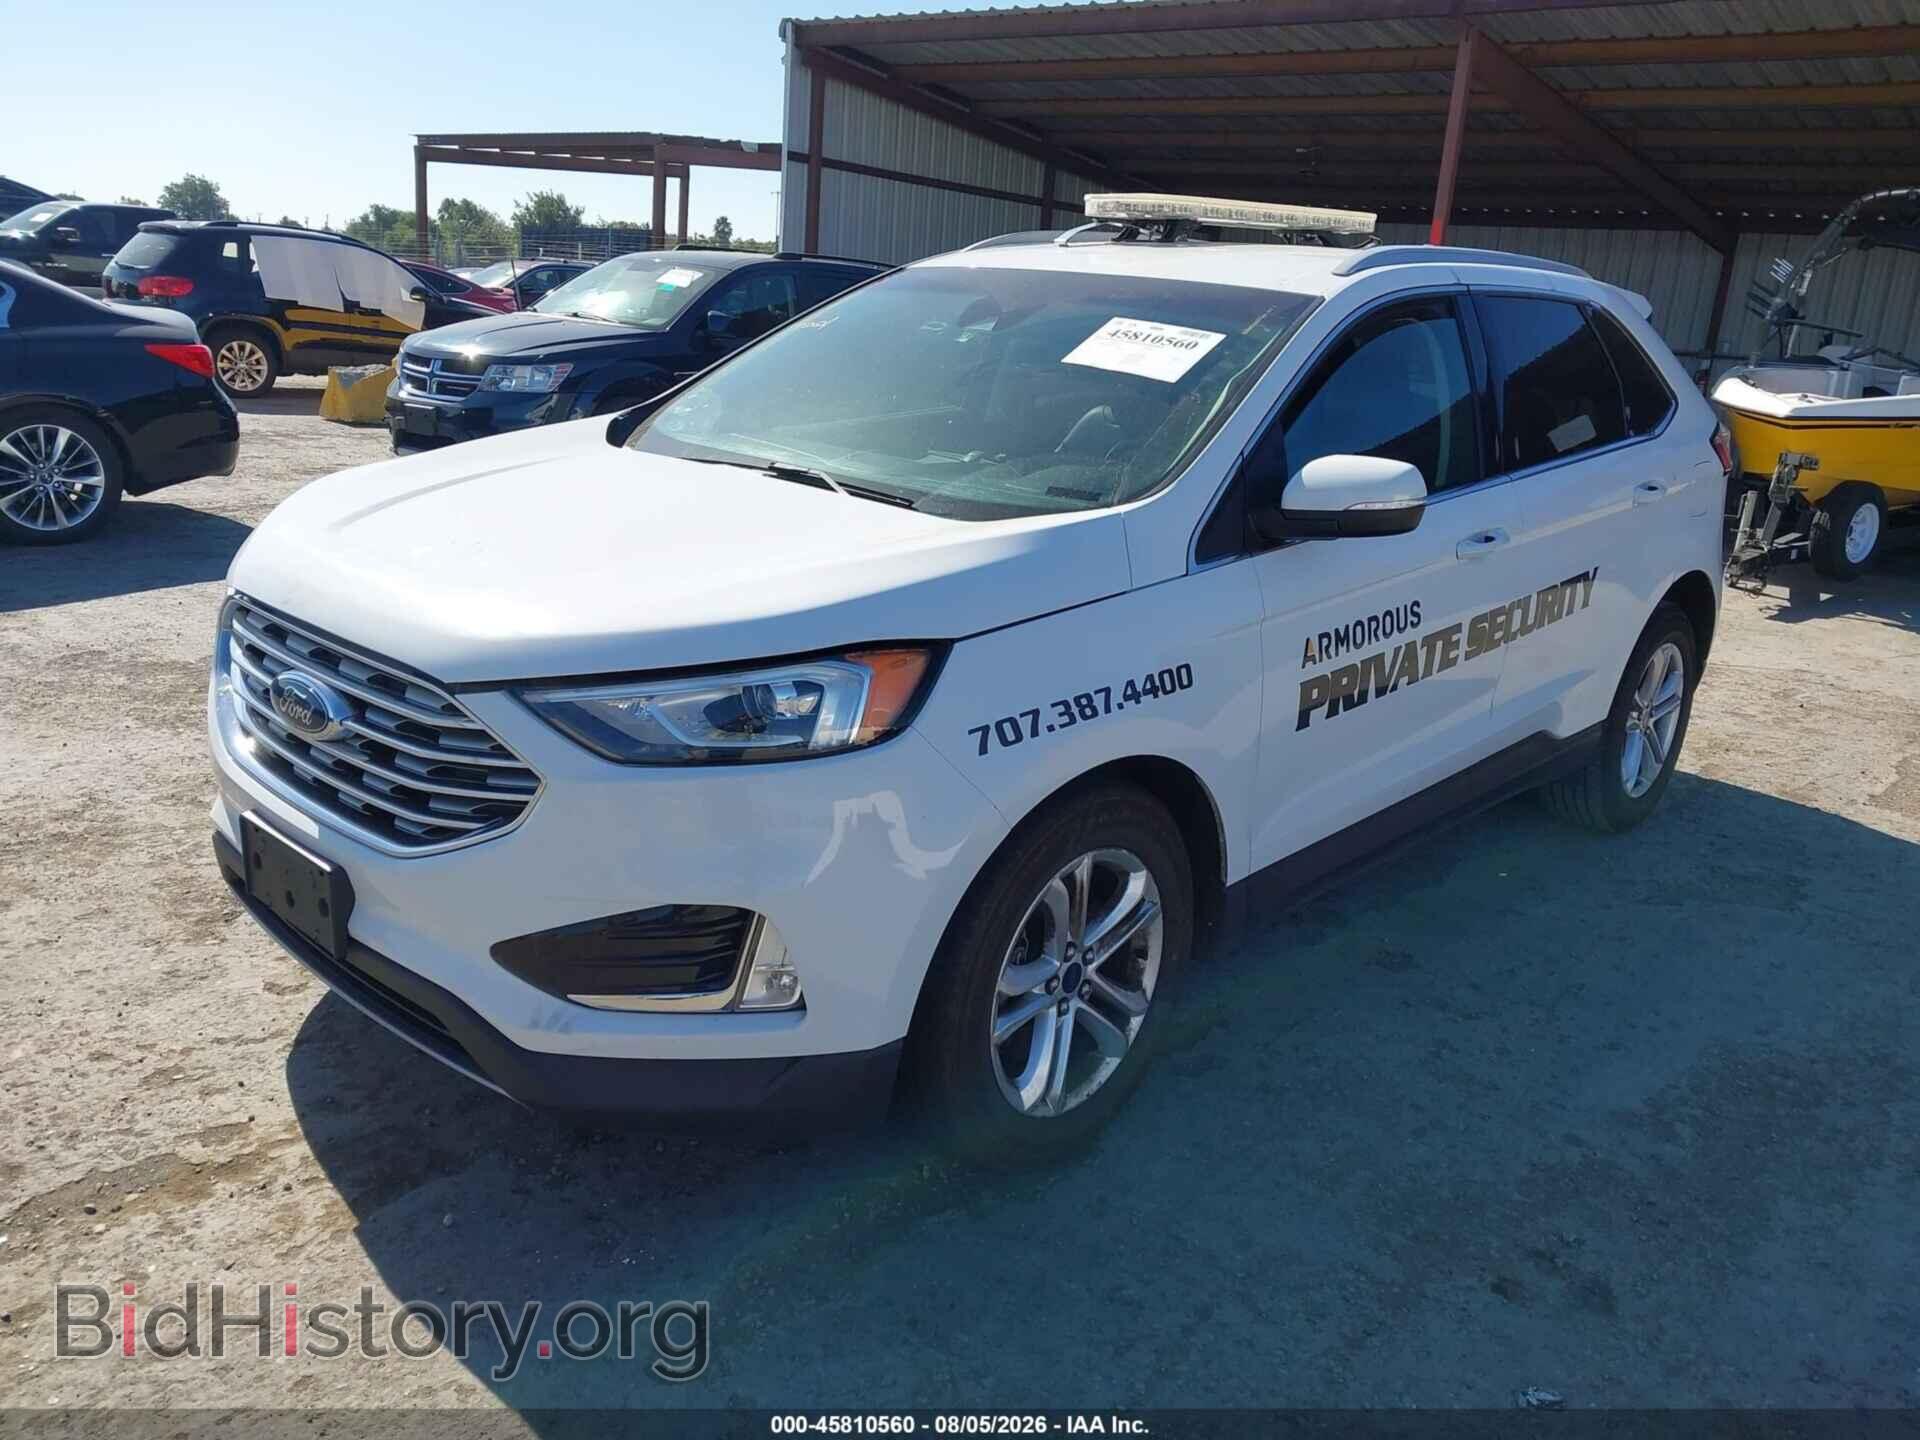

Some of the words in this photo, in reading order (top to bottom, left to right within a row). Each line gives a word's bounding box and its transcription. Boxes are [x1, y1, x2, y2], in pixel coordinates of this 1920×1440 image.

[1108, 328, 1199, 351] 45810560
[1295, 622, 1463, 732] PRIVATE
[1464, 566, 1600, 662] SECURITY
[1302, 599, 1422, 669] ARMOROUS
[279, 686, 313, 726] Ford
[968, 662, 1194, 757] 707.387.4400
